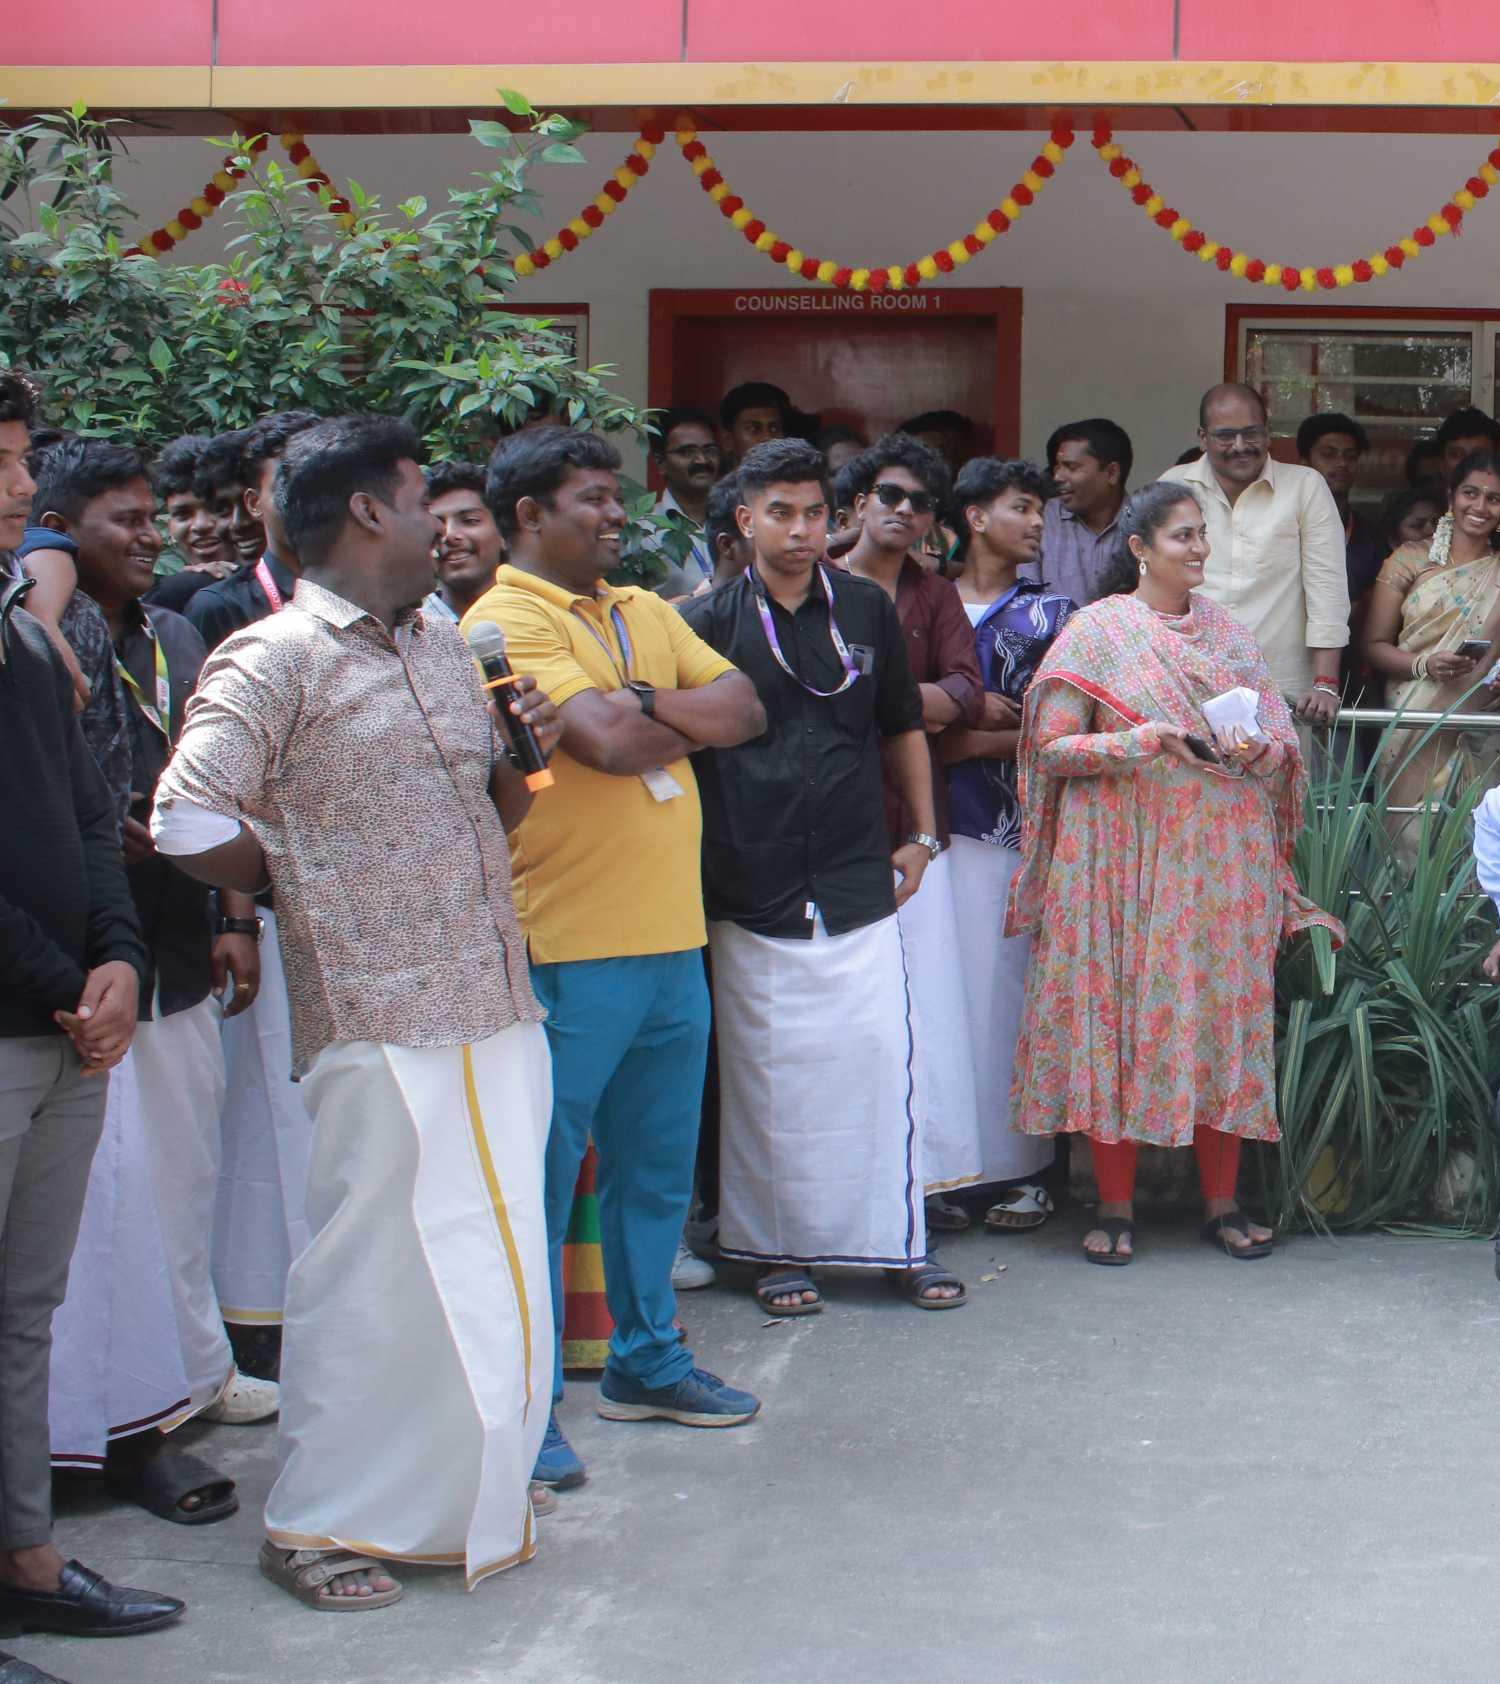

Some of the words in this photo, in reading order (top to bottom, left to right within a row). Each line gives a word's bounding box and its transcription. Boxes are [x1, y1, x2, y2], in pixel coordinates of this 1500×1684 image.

[735, 295, 864, 311] COUNSELLING
[870, 295, 927, 310] ROOM
[933, 295, 941, 309] 1
